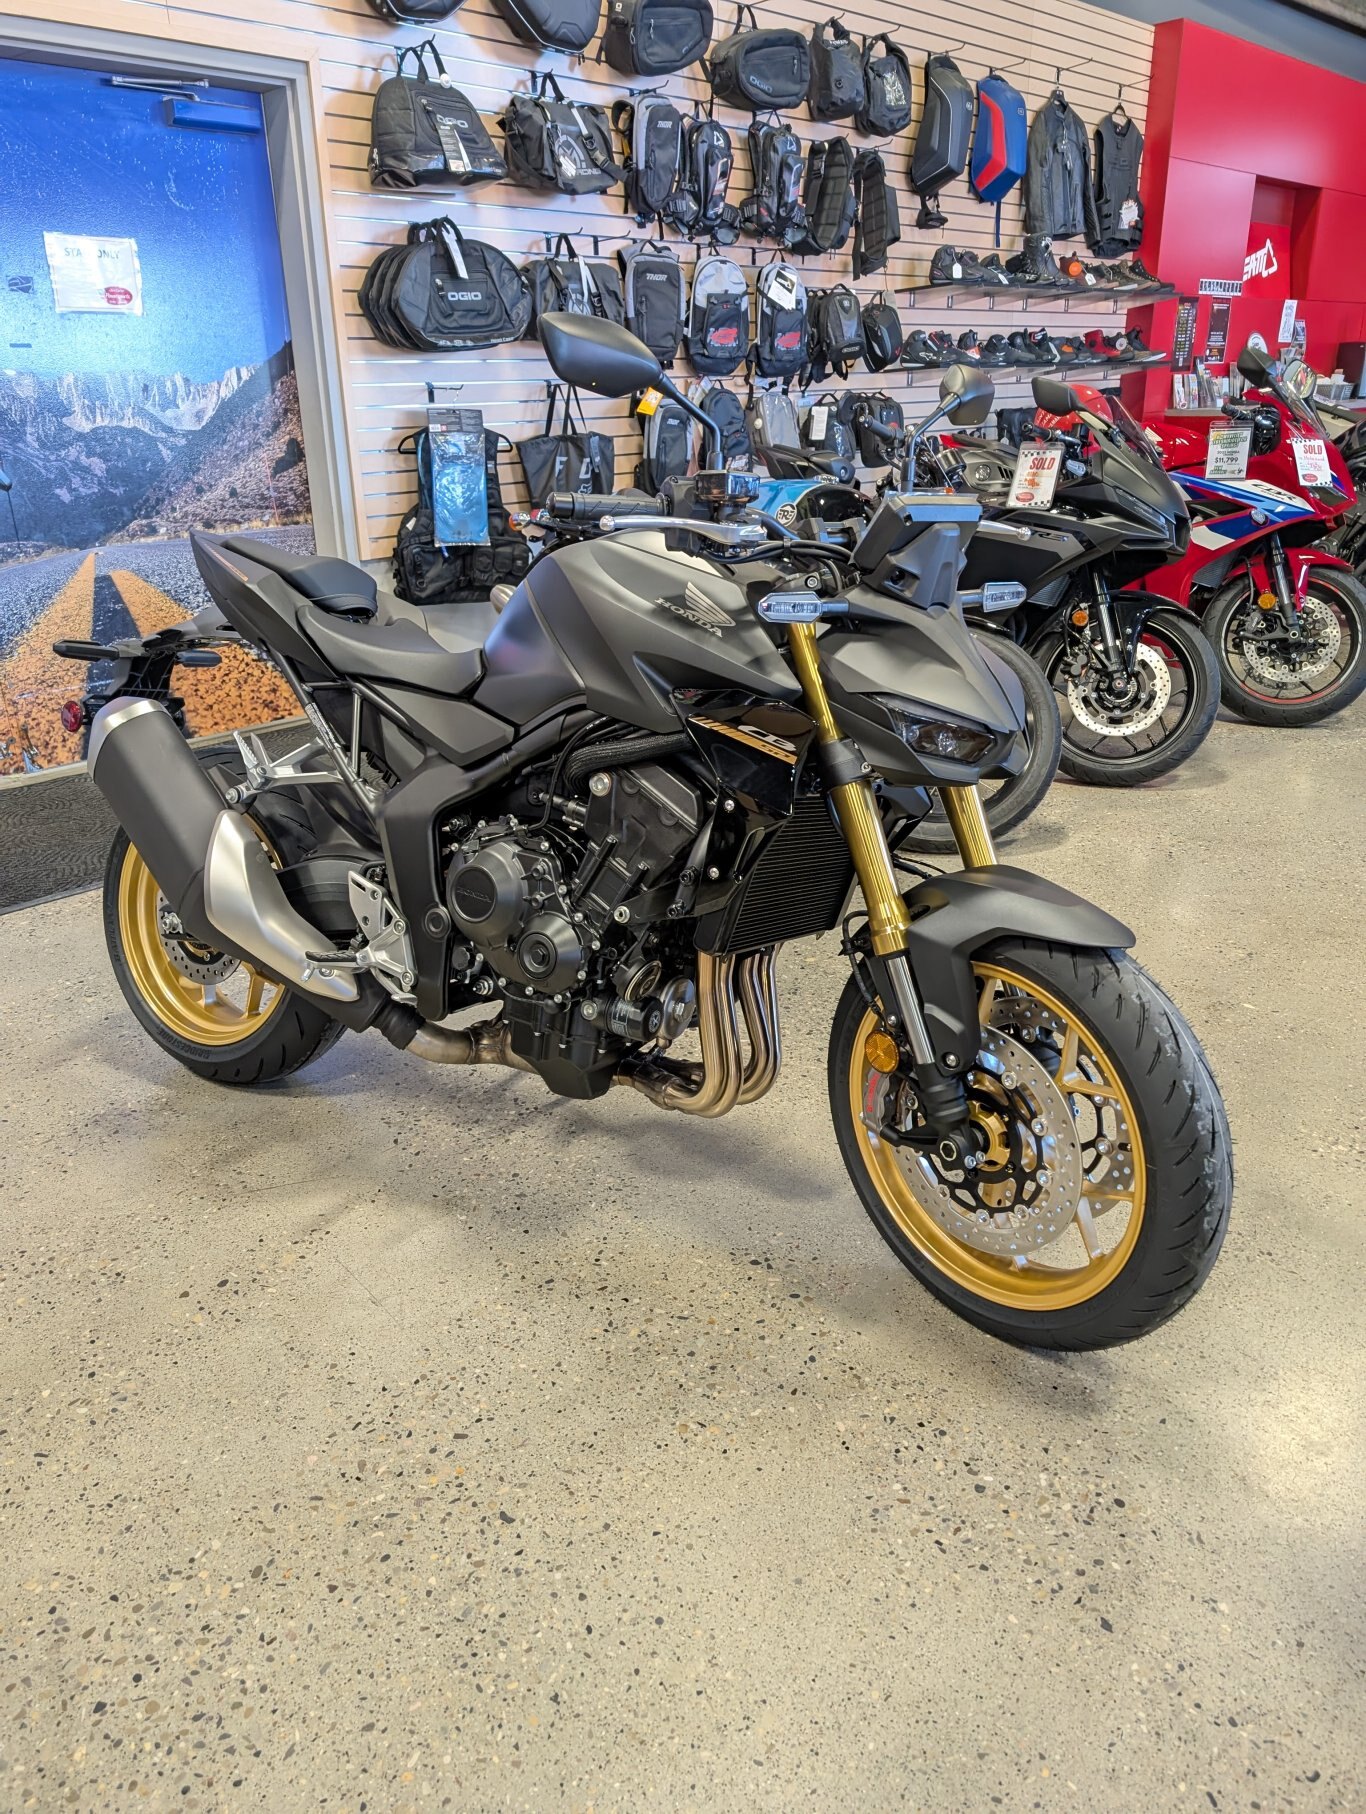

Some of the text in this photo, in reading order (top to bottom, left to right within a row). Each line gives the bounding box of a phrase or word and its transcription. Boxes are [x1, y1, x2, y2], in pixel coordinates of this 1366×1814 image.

[646, 272, 668, 281] THOR
[447, 291, 482, 301] OGIO
[1303, 443, 1323, 455] SOLD
[1029, 457, 1055, 470] SOLD
[1215, 456, 1239, 464] $11,799
[654, 597, 723, 638] HONDA
[738, 725, 797, 752] CB
